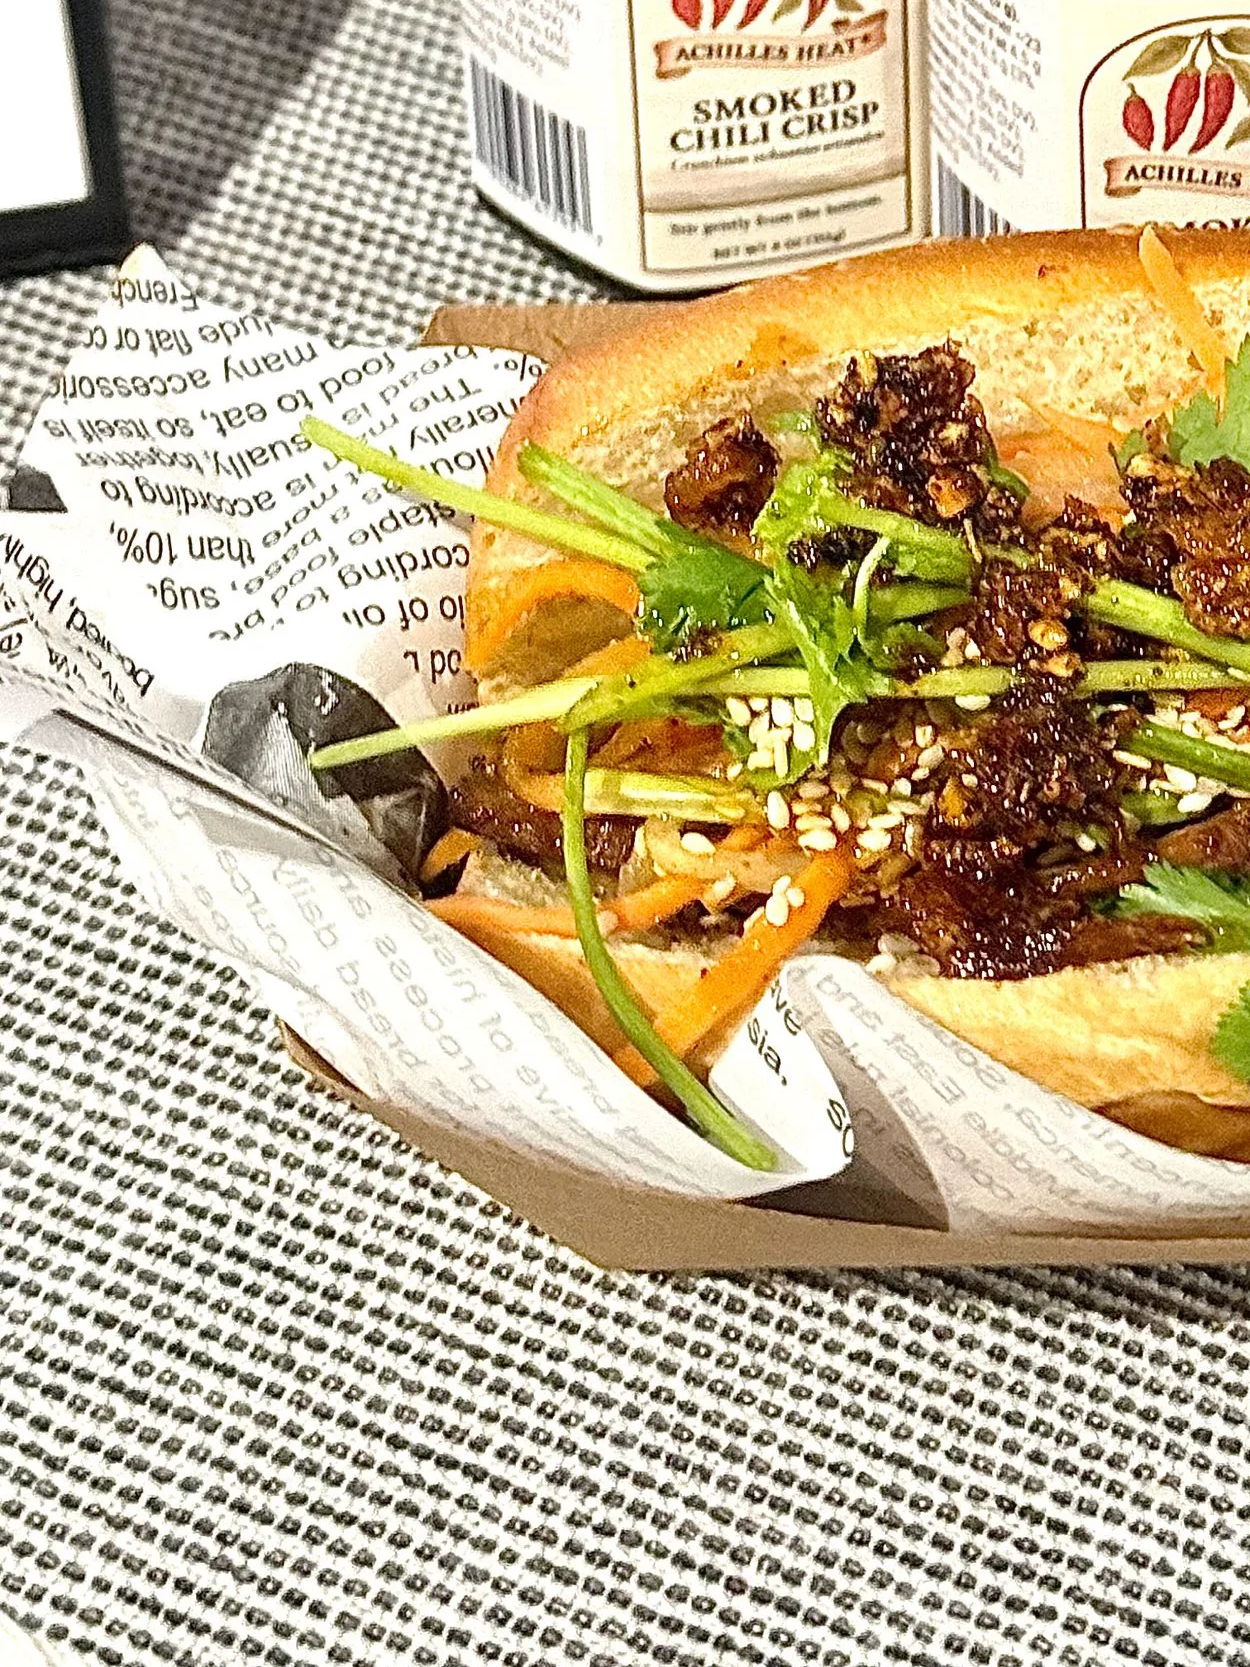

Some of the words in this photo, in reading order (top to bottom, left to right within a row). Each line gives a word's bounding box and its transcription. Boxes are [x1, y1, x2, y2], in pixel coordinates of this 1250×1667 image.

[675, 42, 790, 63] ACHILLES
[693, 78, 858, 125] SMOKED
[669, 121, 771, 153] CHILI
[781, 100, 880, 141] CRISP
[1124, 164, 1242, 188] ACHILLES
[222, 342, 319, 384] many
[319, 351, 396, 404] food
[276, 388, 315, 416] to
[100, 478, 134, 508] to
[134, 475, 277, 518] according
[187, 533, 256, 569] than
[397, 596, 429, 632] of
